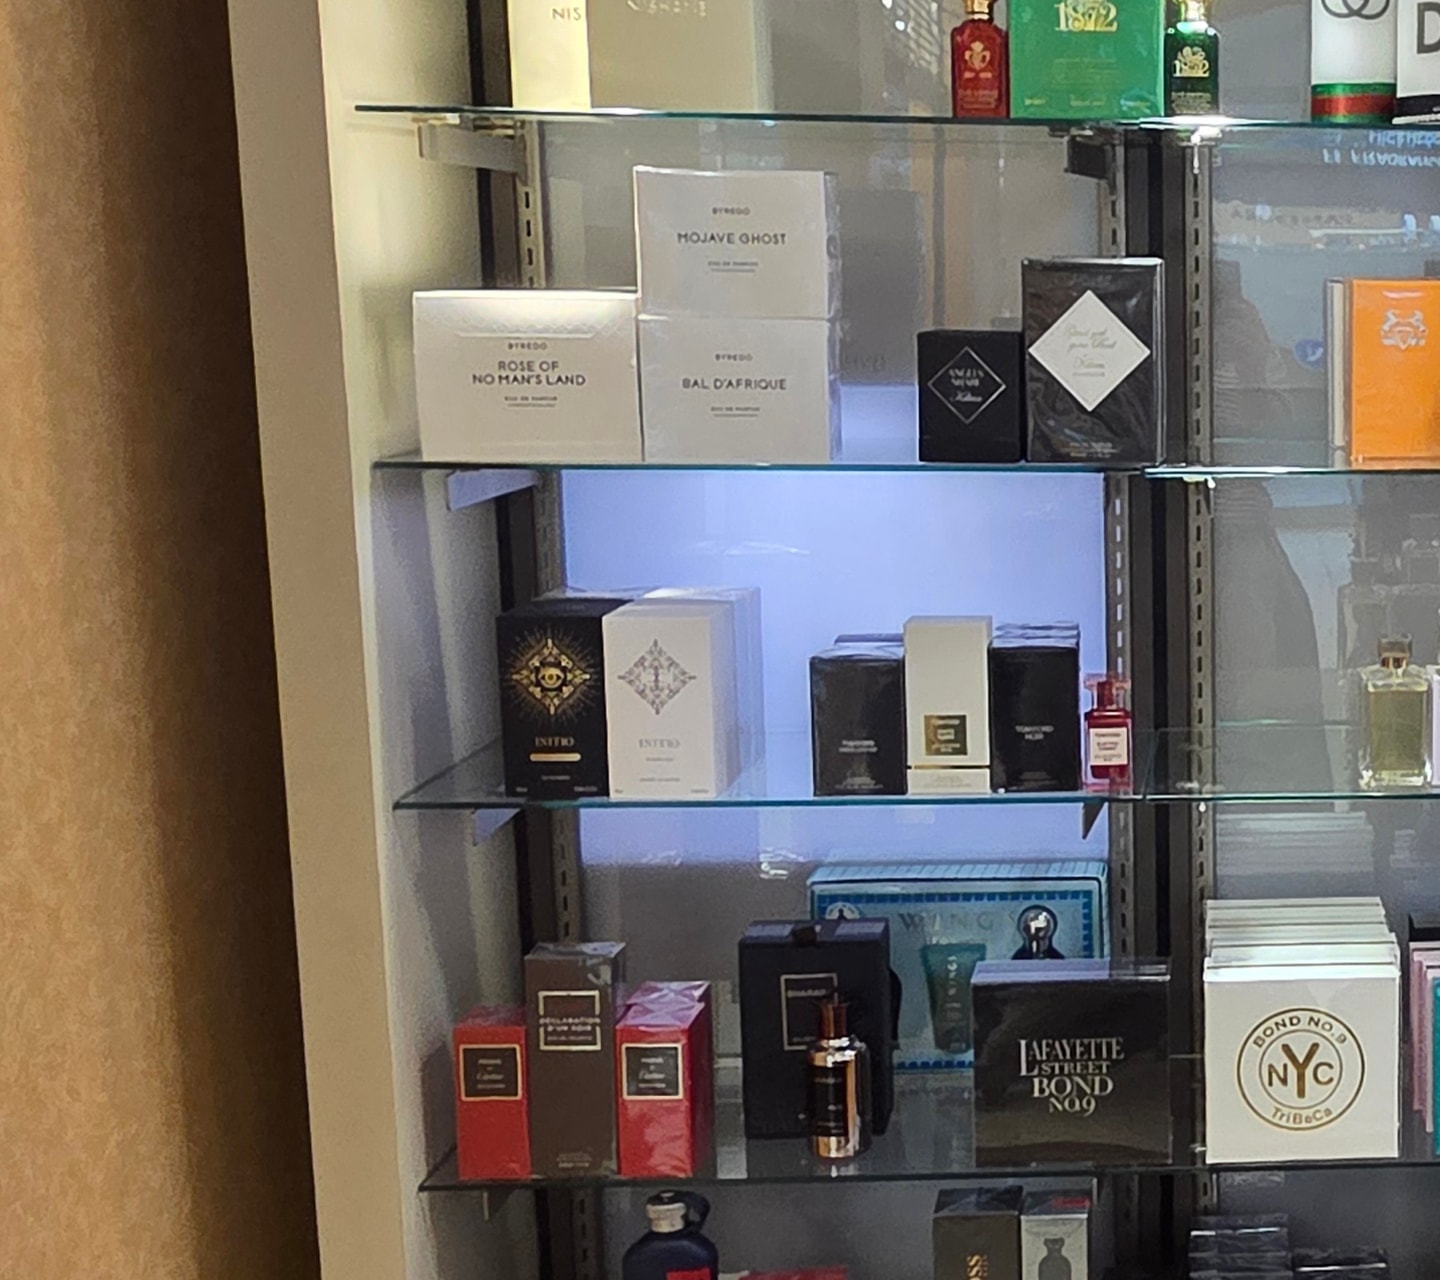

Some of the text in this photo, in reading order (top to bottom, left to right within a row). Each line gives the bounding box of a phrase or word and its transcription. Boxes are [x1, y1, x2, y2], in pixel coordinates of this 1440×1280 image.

[1054, 0, 1118, 33] 1872
[677, 232, 786, 246] MOJAVE GHOST
[498, 360, 560, 373] ROSE OF
[472, 373, 586, 387] NO MAN'S LAND
[682, 378, 787, 391] BAL D'AFRIQUE
[1252, 1015, 1348, 1049] BOND NO.9
[1018, 1036, 1125, 1076] LAFAYETTE
[1040, 1060, 1111, 1075] STREET
[1267, 1042, 1335, 1099] NYC
[1031, 1076, 1114, 1098] BOND
[1271, 1105, 1333, 1125] TriBeCa
